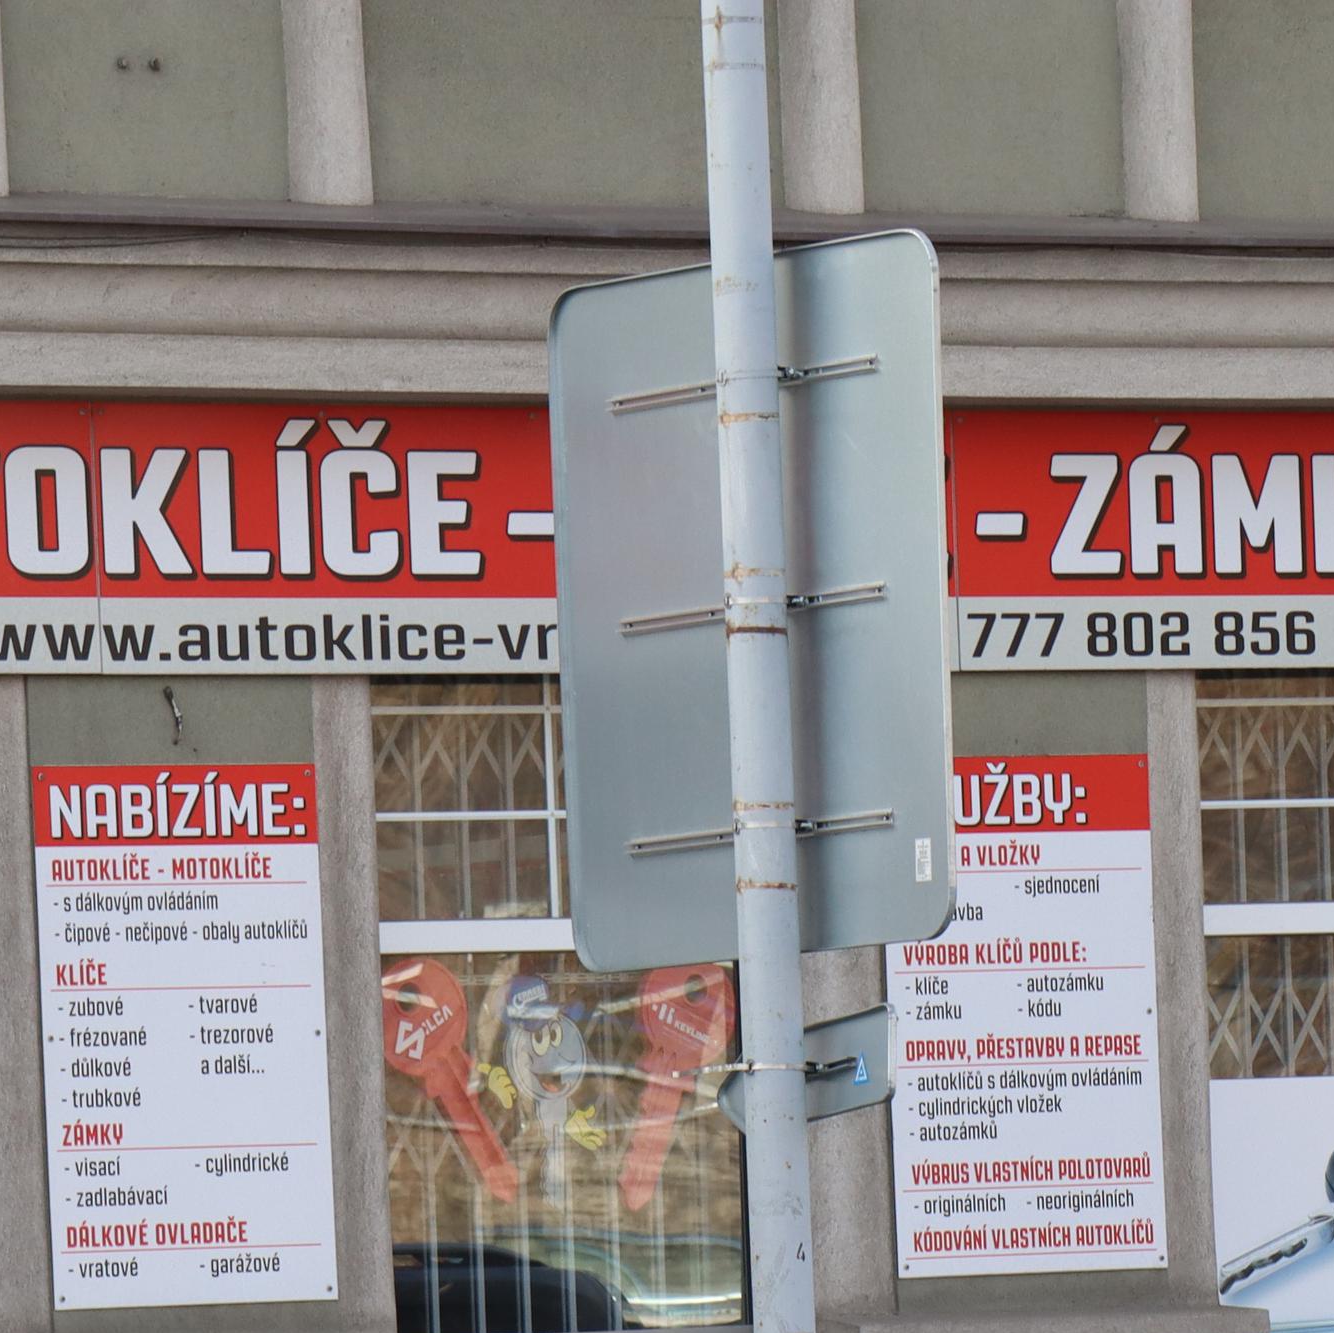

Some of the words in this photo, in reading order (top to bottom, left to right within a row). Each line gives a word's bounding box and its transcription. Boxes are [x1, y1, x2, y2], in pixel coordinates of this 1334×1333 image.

[967, 612, 1065, 659] 777
[1086, 612, 1192, 657] 802
[1214, 610, 1317, 656] 856
[48, 771, 307, 840] NABÍZÍME:
[961, 845, 971, 867] A
[977, 839, 1041, 866] VLOŽKY
[51, 852, 151, 882] AUTOKLÍČE
[171, 851, 273, 881] MOTOKLÍČE
[1024, 874, 1100, 898] sjednocení
[63, 896, 72, 912] s
[75, 892, 143, 915] dálkovým
[147, 891, 219, 912] ovládáním
[64, 922, 110, 946] čipové
[125, 921, 188, 945] nečipové
[202, 921, 240, 944] obaly
[244, 918, 308, 941] autoklíčů
[903, 940, 969, 966] VÝROBA
[975, 936, 1023, 965] KLÍČŮ
[1029, 941, 1087, 963] PODLE:
[56, 958, 107, 987] KLÍČE
[1027, 973, 1104, 993] autozámku
[915, 976, 949, 996] klíče
[68, 996, 124, 1017] zubové
[199, 993, 258, 1015] tvarové
[915, 1001, 962, 1021] zámku
[1028, 998, 1062, 1018] kódu
[69, 1026, 147, 1048] frézované
[200, 1023, 274, 1045] trezorové
[905, 1039, 971, 1063] OPRAVY,
[977, 1033, 1065, 1060] PŘESTAVBY
[1070, 1036, 1079, 1057] A
[1085, 1034, 1142, 1056] REPASE
[71, 1056, 131, 1078] důlkové
[201, 1060, 210, 1075] a
[214, 1055, 265, 1075] další...
[917, 1070, 983, 1092] autoklíčů
[987, 1075, 996, 1090] s
[999, 1068, 1067, 1091] dálkovým
[1071, 1067, 1142, 1087] ovládáním
[72, 1087, 141, 1108] trubkové
[918, 1095, 1013, 1120] cylindrických
[1017, 1094, 1062, 1113] vložek
[62, 1119, 124, 1147] ZÁMKY
[919, 1120, 998, 1141] autozámků
[75, 1156, 121, 1177] visací
[205, 1151, 289, 1176] cylindrické
[911, 1159, 970, 1185] VÝBRUS
[973, 1155, 1053, 1183] VLASTNÍCH
[1058, 1152, 1151, 1180] POLOTOVARŮ
[76, 1185, 168, 1208] zadlabávací
[923, 1194, 1006, 1218] originálních
[1036, 1189, 1134, 1212] neoriginálních
[67, 1219, 149, 1248] DÁLKOVÉ
[155, 1216, 248, 1245] OVLADAČE
[913, 1225, 987, 1253] KÓDOVÁNÍ
[991, 1221, 1071, 1249] VLASTNÍCH
[1075, 1218, 1155, 1246] AUTOKLÍČŮ
[79, 1256, 138, 1279] vratové
[210, 1252, 280, 1277] garážové
